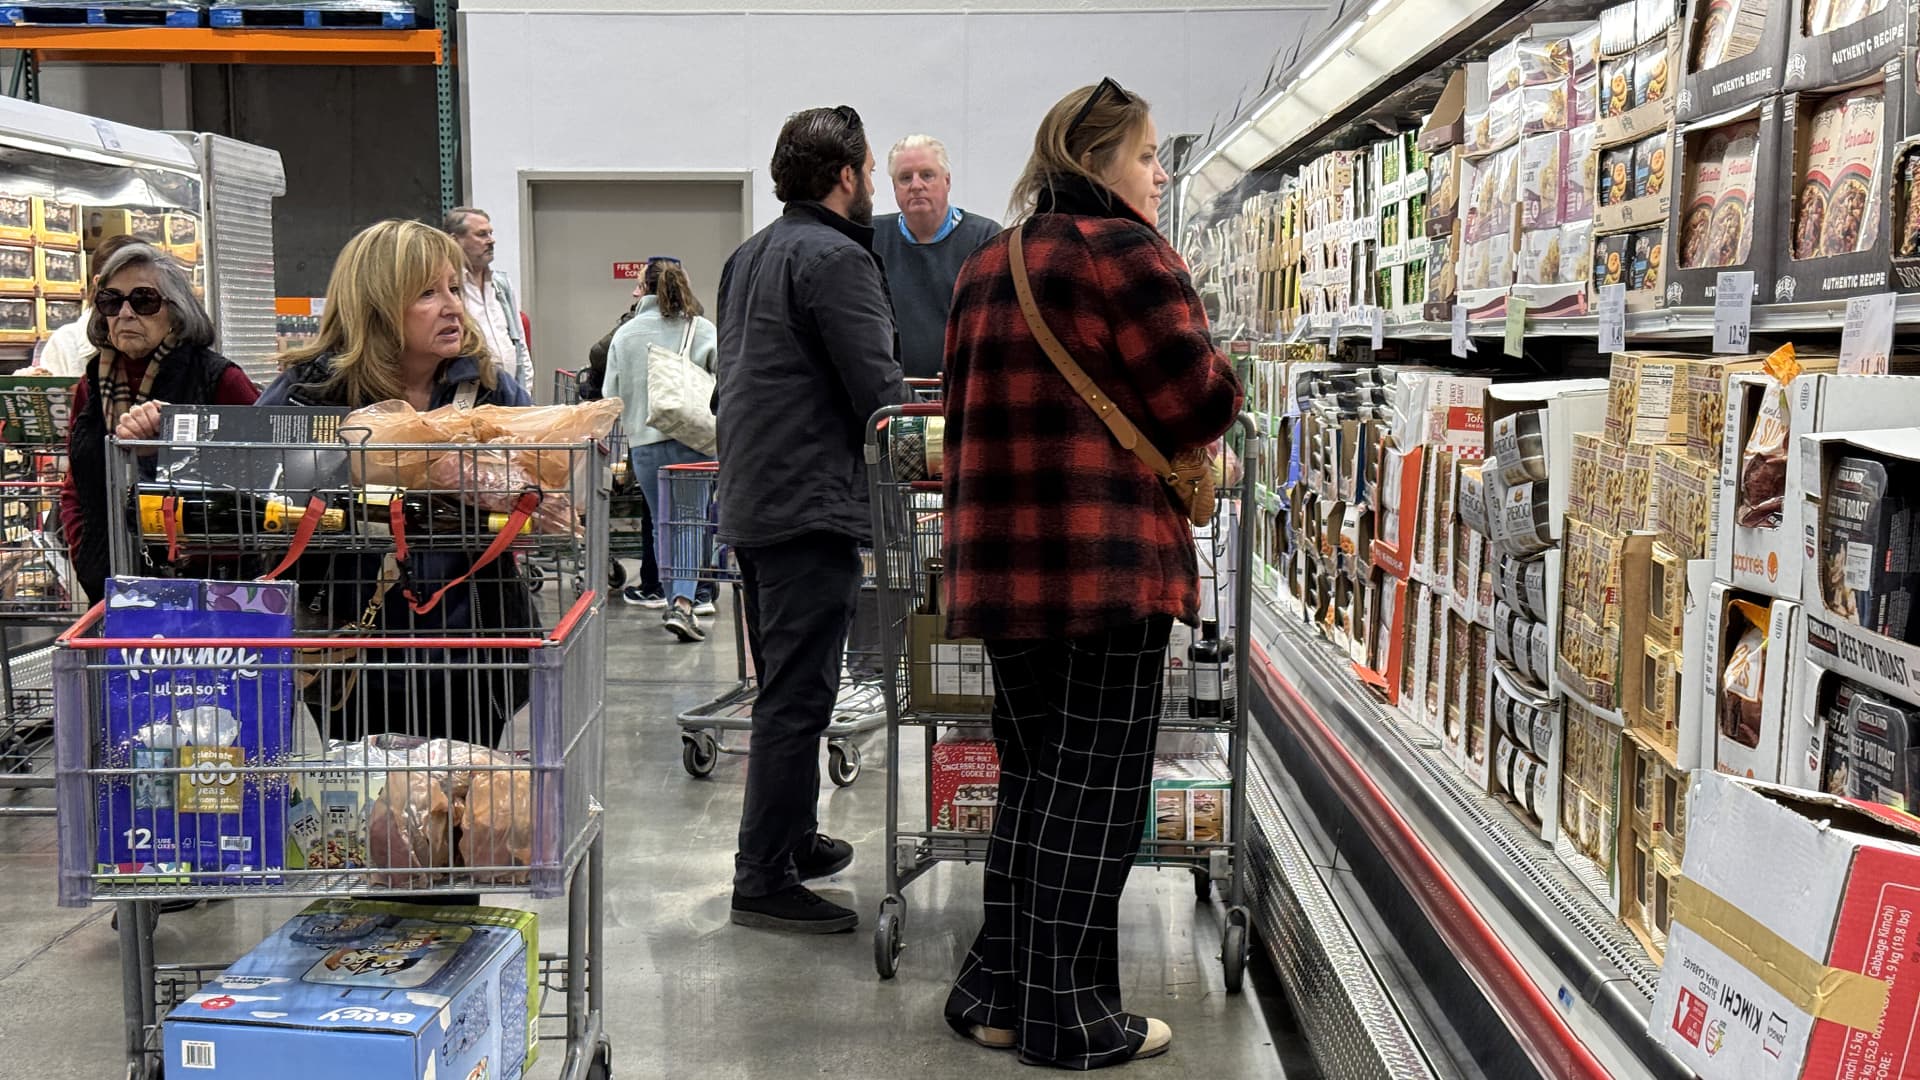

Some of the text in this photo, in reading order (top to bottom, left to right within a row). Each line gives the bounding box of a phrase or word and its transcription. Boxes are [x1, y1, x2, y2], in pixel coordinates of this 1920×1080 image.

[1832, 24, 1905, 65] AUTHENTC RECIPE
[1712, 74, 1745, 96] AUTHENTIC
[1745, 67, 1773, 85] RECIPE
[1822, 272, 1886, 291] AUTHENTIC RECIPE
[1847, 498, 1870, 521] ROAST
[1838, 630, 1859, 667] BEEF
[1859, 641, 1874, 673] POT
[1878, 649, 1910, 688] ROAST
[941, 763, 985, 772] GINGERBREAD
[123, 828, 152, 850] 12
[1877, 905, 1897, 938] Kimchi)
[1899, 909, 1912, 928] lbs)
[1892, 927, 1906, 953] (19.8
[1868, 935, 1890, 978] Cabbage
[1892, 952, 1904, 965] kg
[1890, 964, 1898, 972] 9
[1719, 983, 1764, 1035] KIMCHI
[1855, 1032, 1867, 1043] kg
[1849, 1043, 1862, 1057] 1.5
[1861, 1063, 1876, 1078] kg
